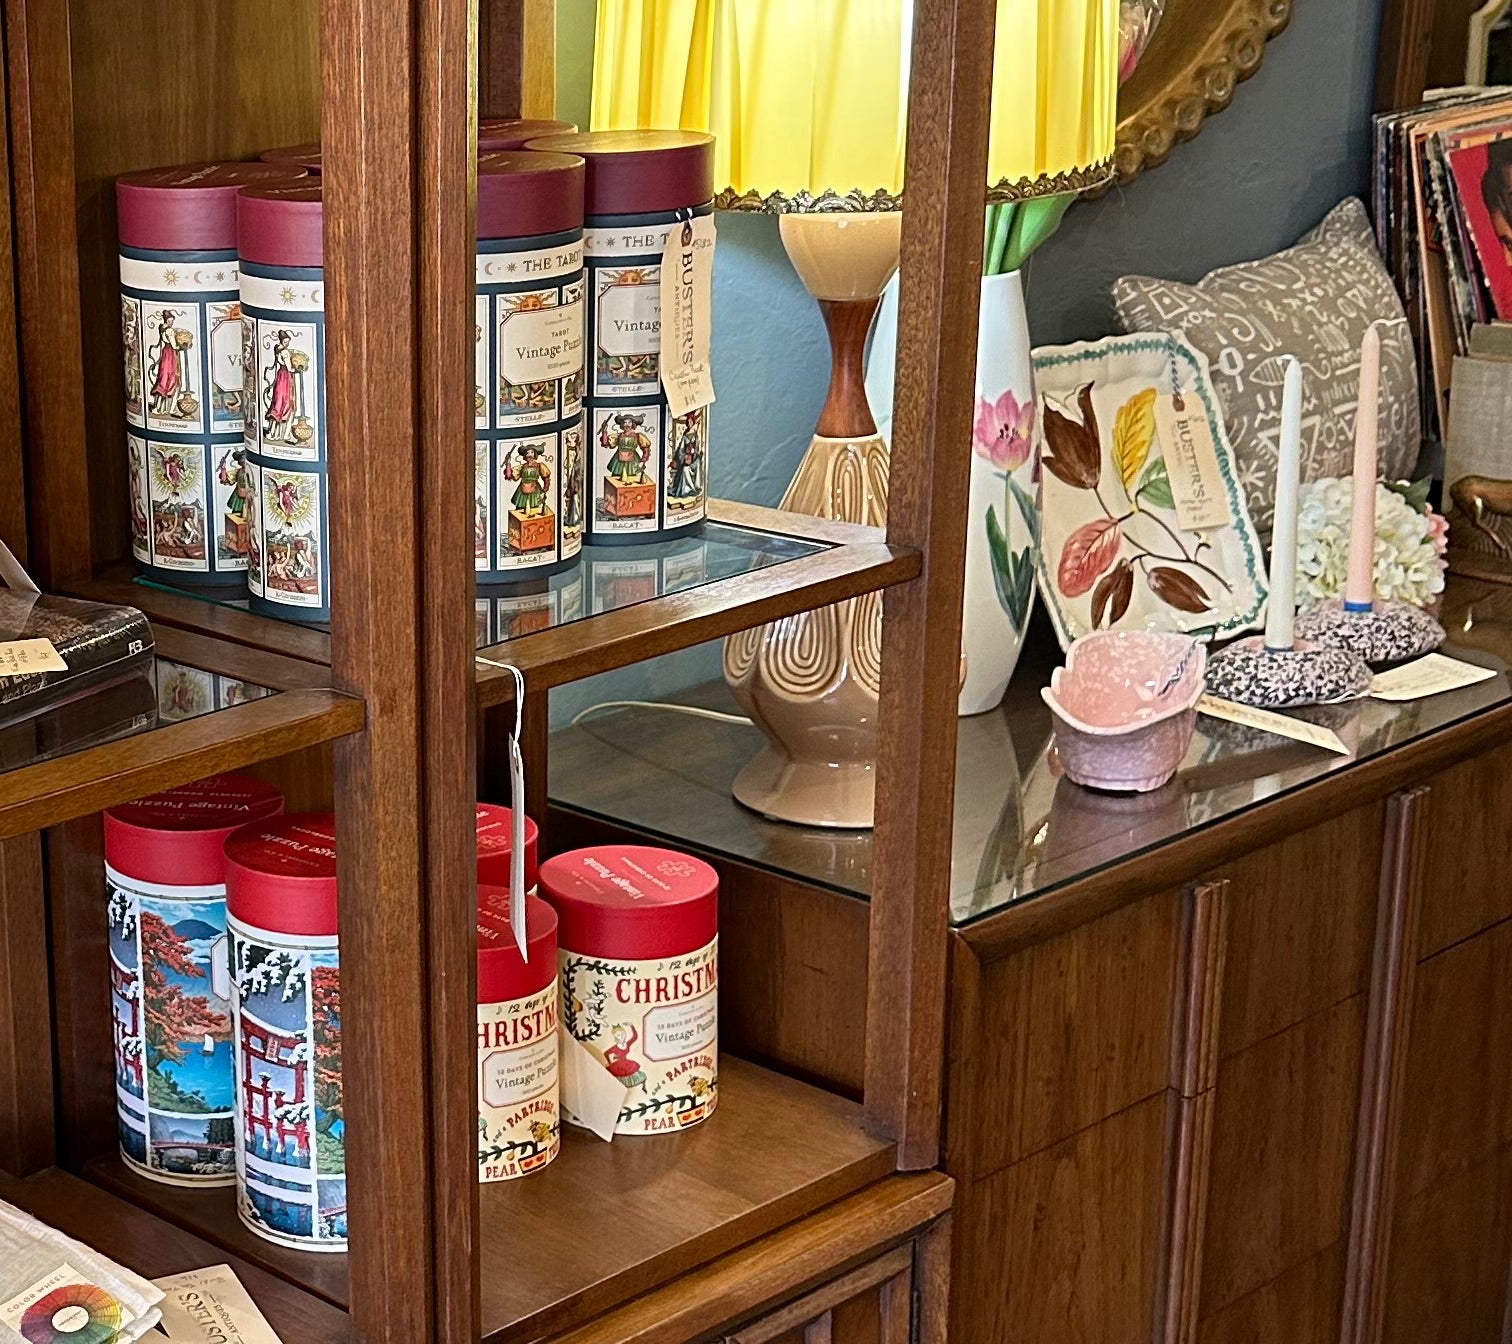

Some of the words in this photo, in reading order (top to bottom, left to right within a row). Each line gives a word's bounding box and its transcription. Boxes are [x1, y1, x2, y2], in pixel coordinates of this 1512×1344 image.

[621, 233, 655, 248] THE
[522, 258, 552, 273] THE
[556, 249, 582, 267] TAROT
[681, 250, 694, 366] BUSTER'S
[613, 320, 662, 333] Vintag
[516, 344, 561, 359] Vintage
[1176, 418, 1205, 498] BUSTER'S
[188, 801, 251, 812] Vintage
[260, 833, 309, 852] Puzzle
[615, 958, 716, 1004] CHRISTM
[478, 1002, 555, 1048] HRISTM
[656, 1029, 694, 1043] Vintage
[495, 1072, 535, 1089] Vintage
[644, 1116, 676, 1130] PEAR
[485, 1162, 518, 1179] PEAR
[6, 1292, 36, 1313] COLOR
[36, 1273, 66, 1294] WHEEL
[213, 1304, 239, 1334] ANTIQUES
